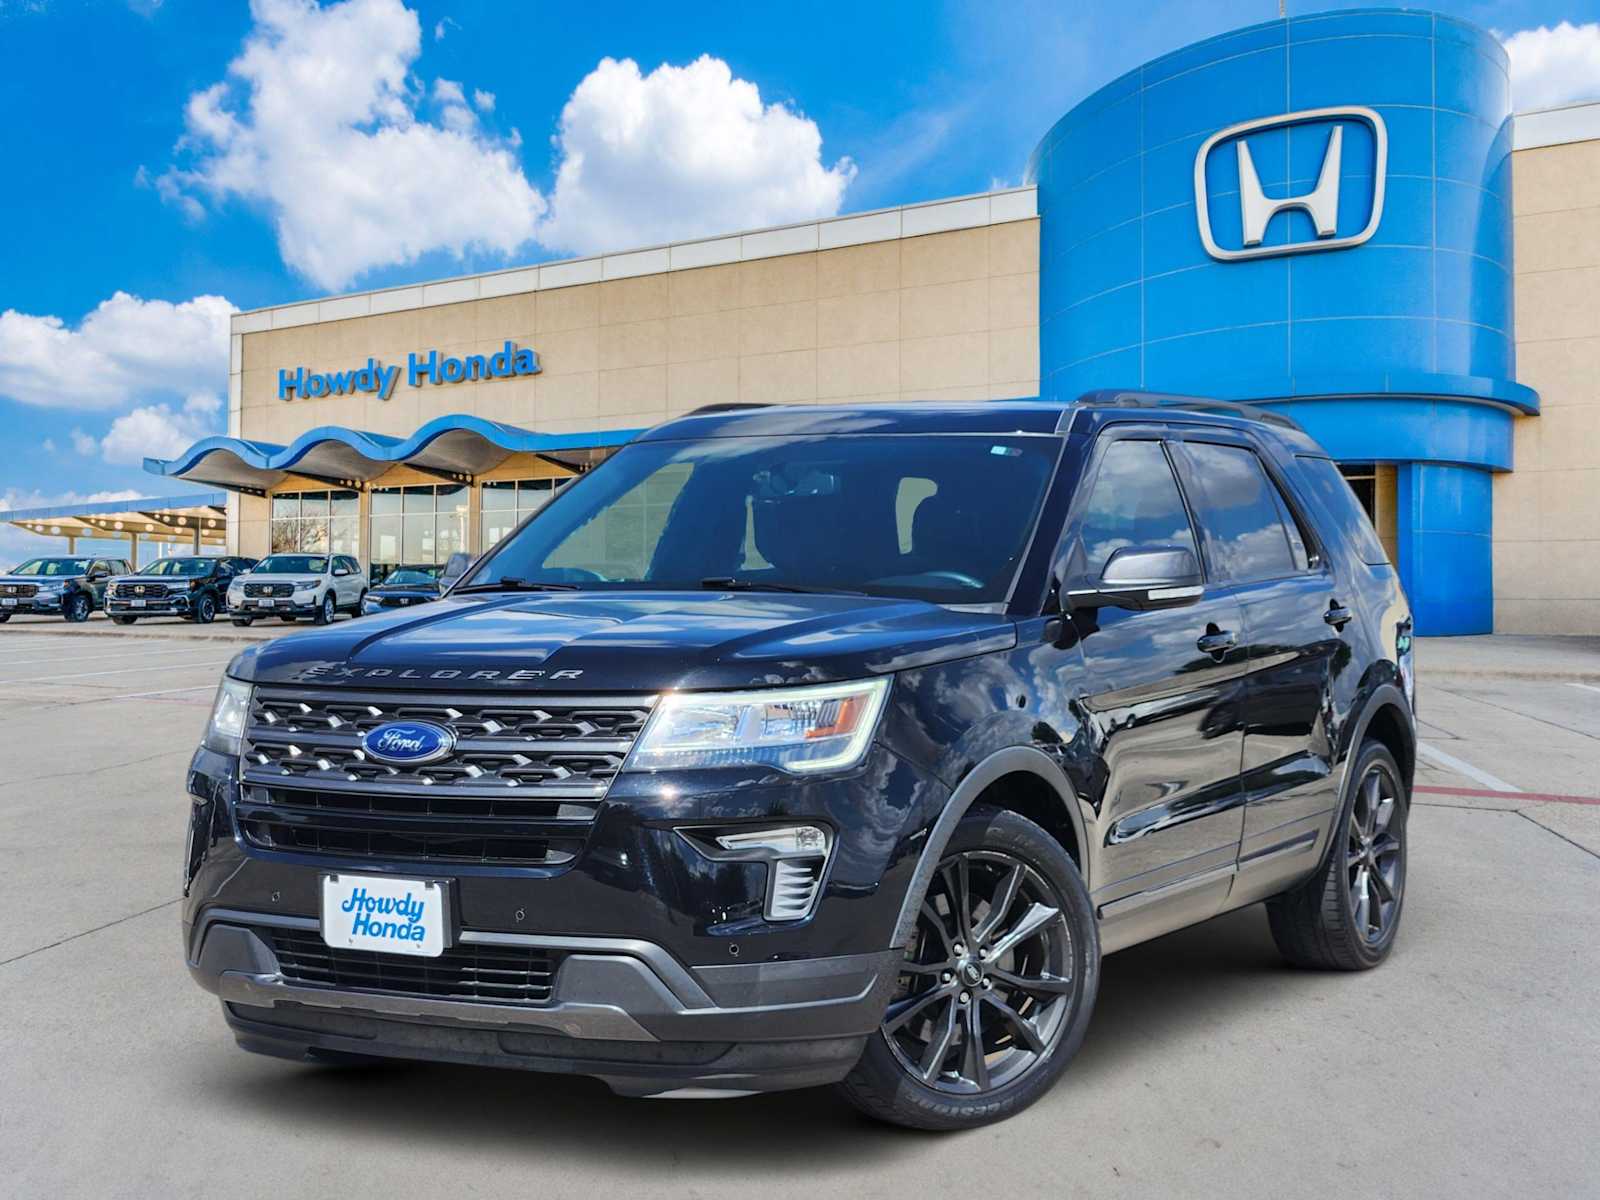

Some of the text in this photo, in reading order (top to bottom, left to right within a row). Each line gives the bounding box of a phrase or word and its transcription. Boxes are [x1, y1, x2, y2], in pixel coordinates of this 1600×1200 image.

[278, 341, 542, 401] Howdy Honda
[303, 666, 584, 681] EXPLORER
[377, 728, 426, 752] Ford
[341, 887, 425, 923] Howdy
[351, 912, 426, 942] Honda
